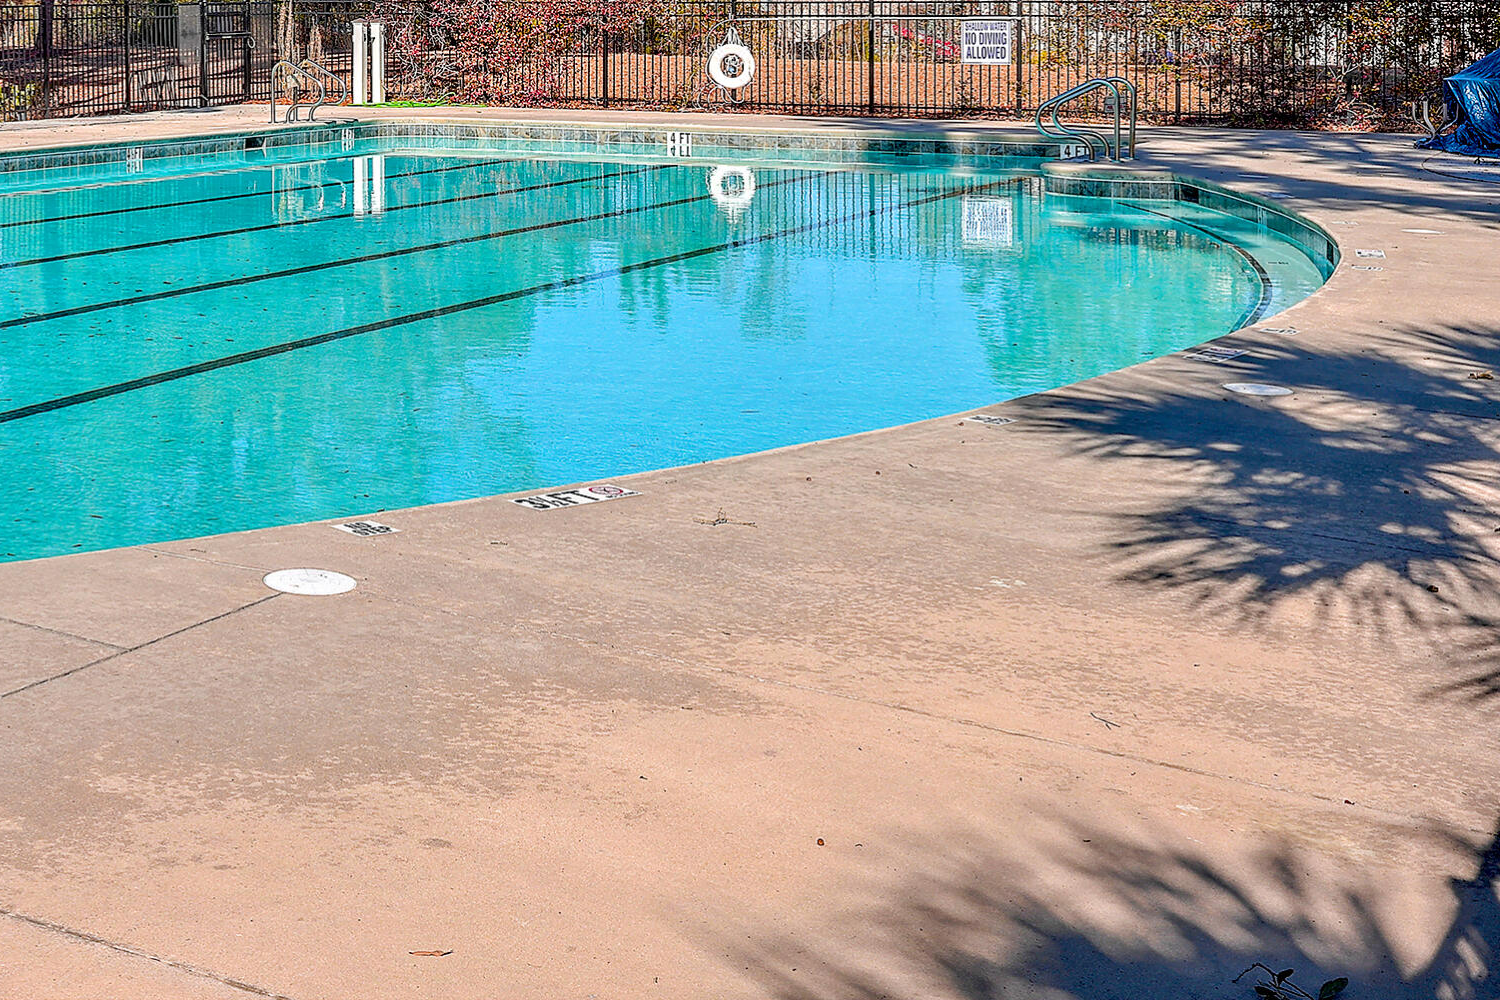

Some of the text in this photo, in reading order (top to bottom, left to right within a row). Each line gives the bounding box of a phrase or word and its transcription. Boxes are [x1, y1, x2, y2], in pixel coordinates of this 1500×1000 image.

[965, 32, 1007, 45] NO DIVING
[966, 46, 1007, 59] ALLOWED
[670, 132, 691, 144] 4 FT
[1064, 145, 1071, 157] 4
